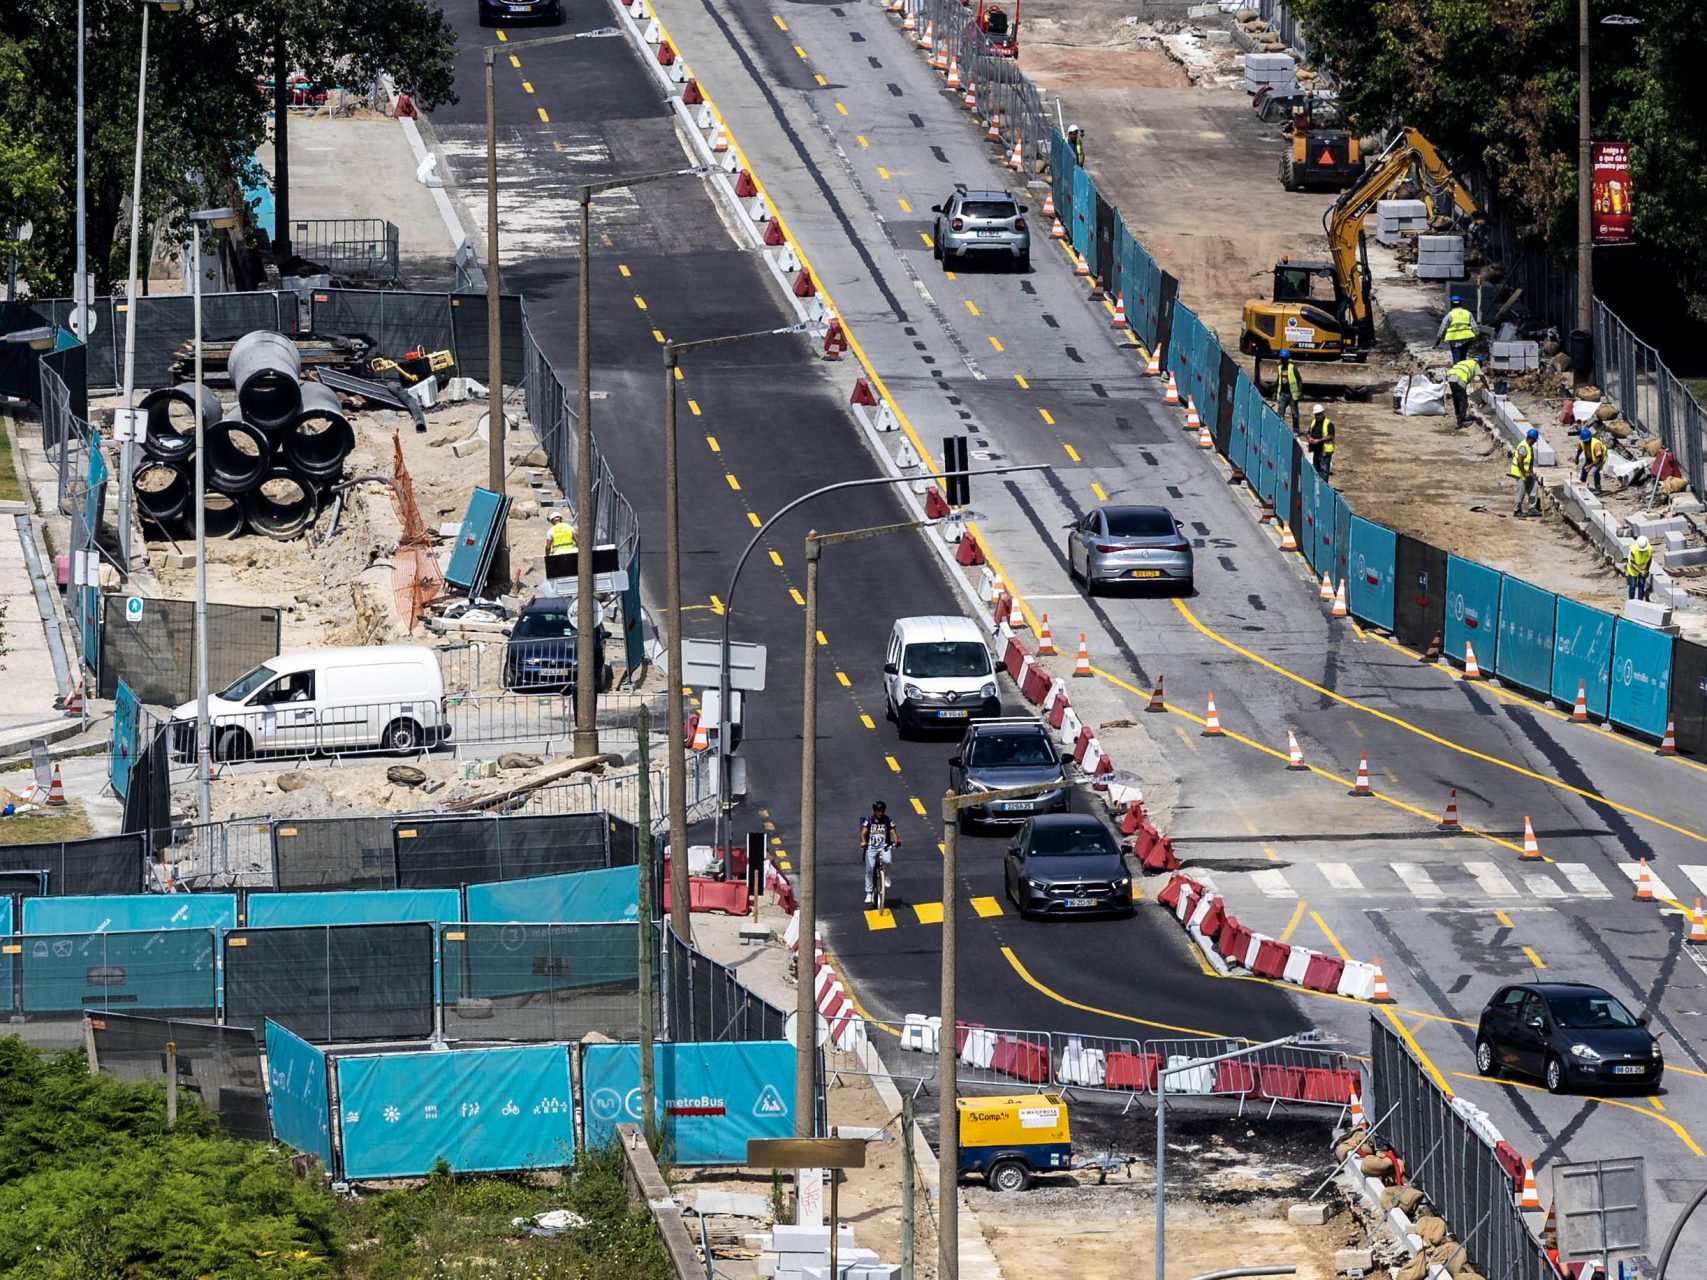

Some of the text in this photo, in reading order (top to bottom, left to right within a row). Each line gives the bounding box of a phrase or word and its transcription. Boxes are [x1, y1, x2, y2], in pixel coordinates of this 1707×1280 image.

[1602, 147, 1619, 155] Amigo
[1594, 163, 1616, 171] primeiro
[665, 1096, 724, 1107] metroBus
